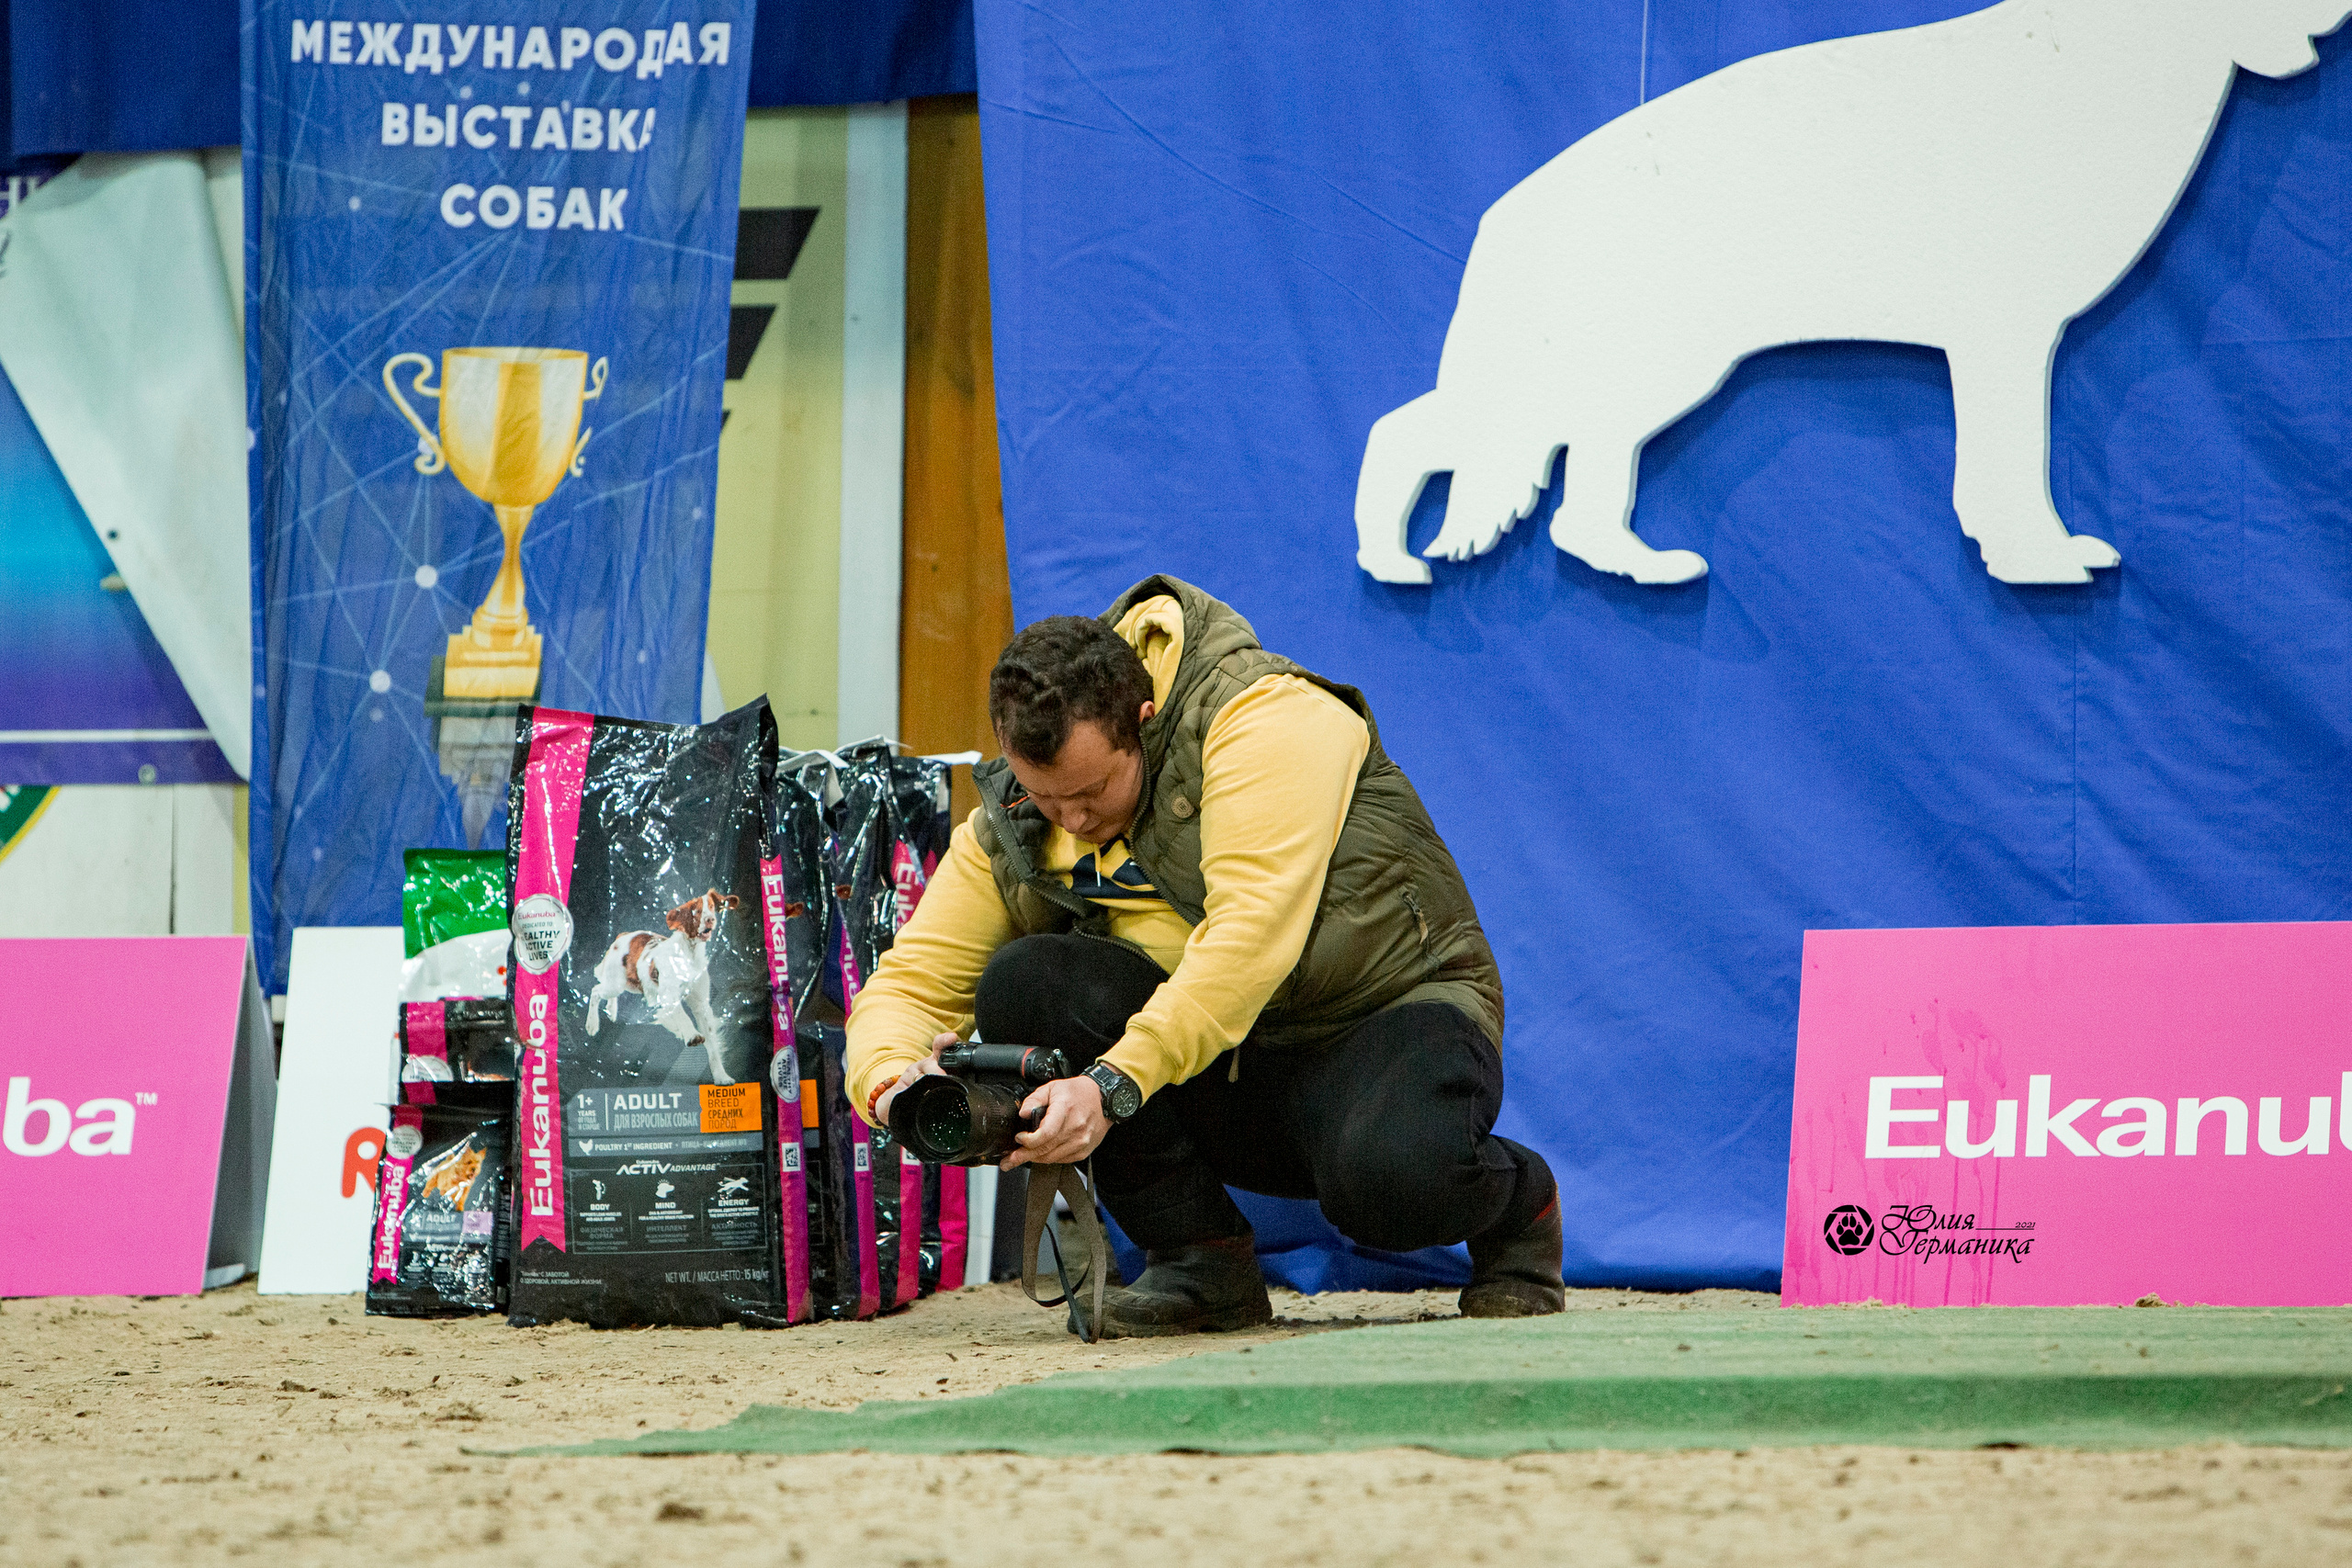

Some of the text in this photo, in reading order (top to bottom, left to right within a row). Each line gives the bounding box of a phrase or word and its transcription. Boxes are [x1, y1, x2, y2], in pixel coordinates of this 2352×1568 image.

[440, 183, 628, 231] СОБАК
[528, 950, 549, 962] LIVES
[707, 1088, 745, 1099] MEDIUM
[528, 994, 554, 1216] Eukanuba
[577, 1094, 594, 1109] 1+
[613, 1092, 682, 1111] ADULT
[707, 1098, 740, 1108] BREED
[707, 1109, 743, 1120] СРЕДНИХ
[614, 1111, 698, 1132] ДЛЯ ВЗРОСЛЫХ СОБАК
[707, 1118, 738, 1130] ПОРОД
[633, 1142, 673, 1150] INGREDIENT
[718, 1199, 750, 1207] ENERGY
[665, 1272, 678, 1283] NET
[697, 1271, 719, 1282] МАССА
[744, 1269, 752, 1280] 15
